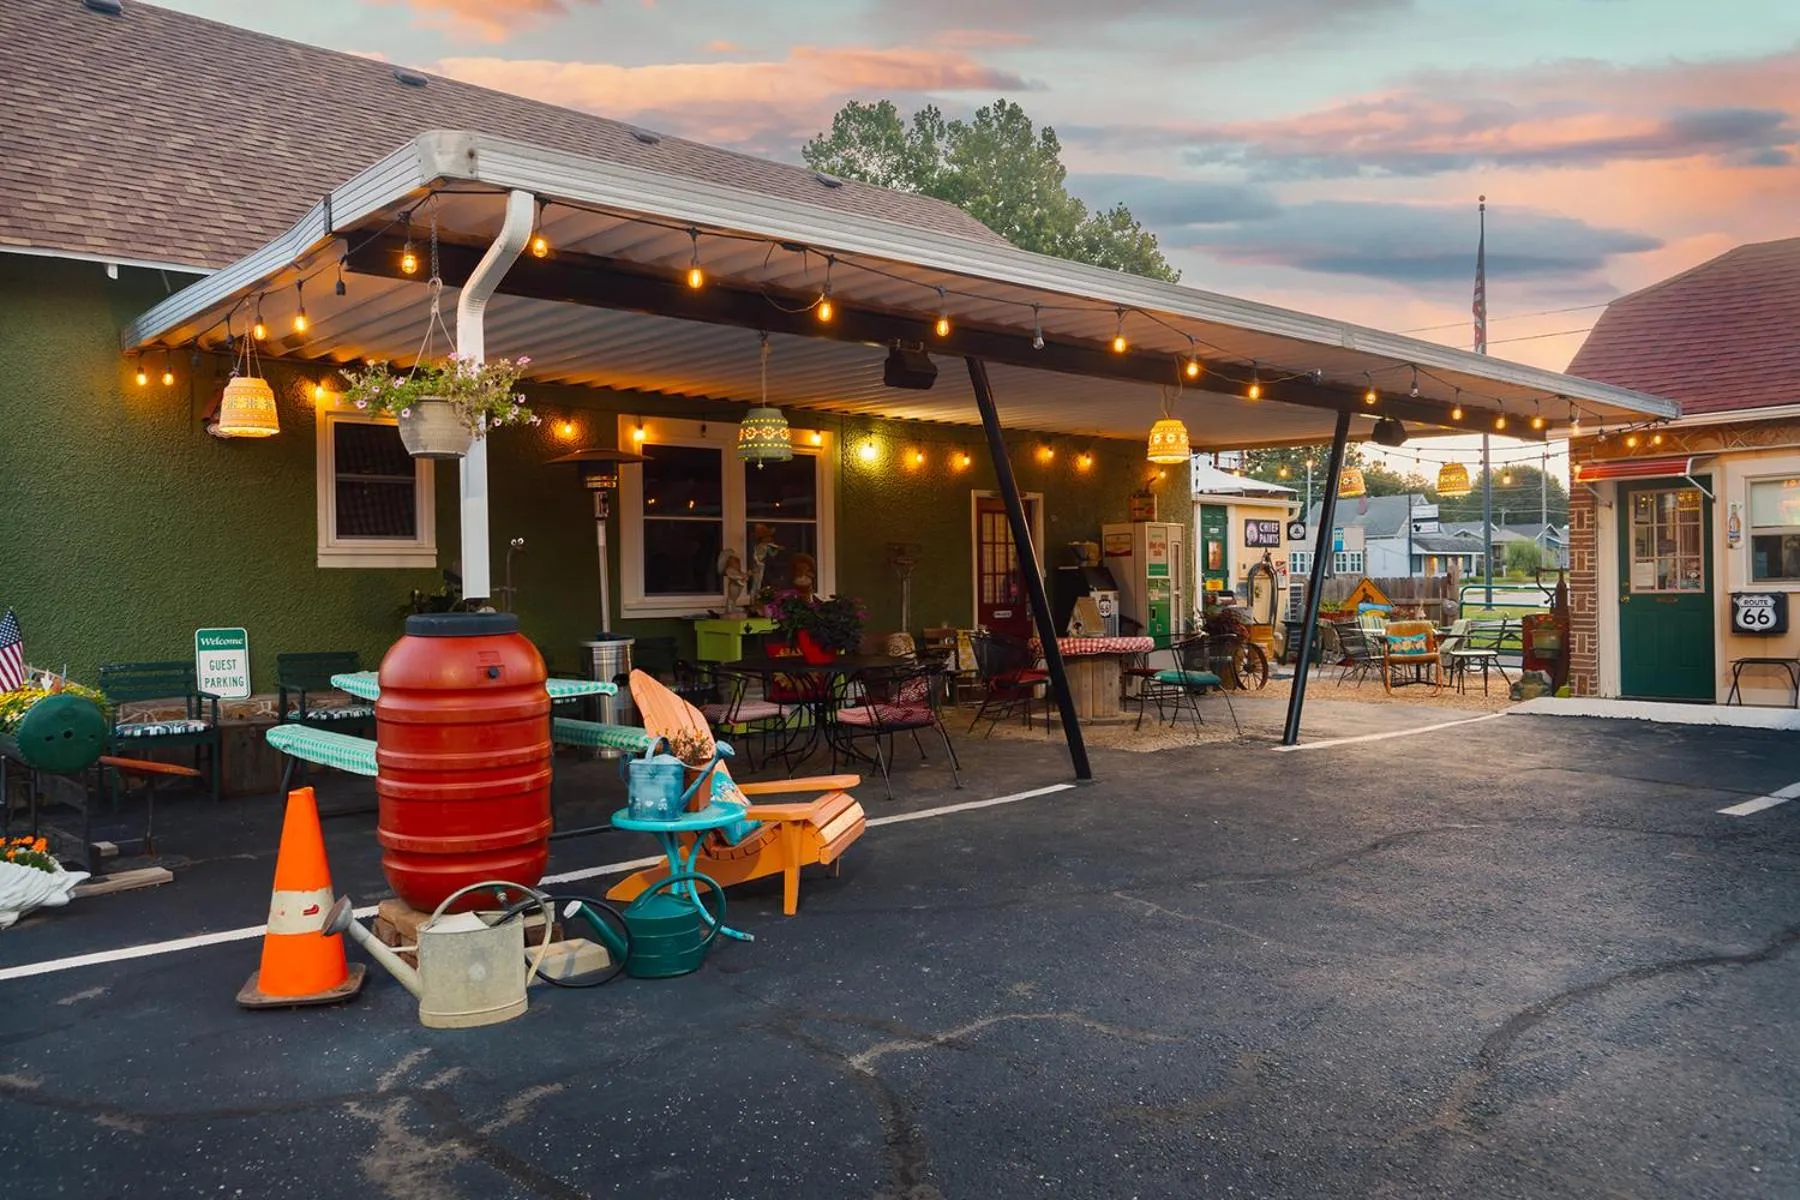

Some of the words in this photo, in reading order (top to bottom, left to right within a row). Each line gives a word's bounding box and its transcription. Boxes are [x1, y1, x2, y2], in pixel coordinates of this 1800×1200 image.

[1259, 522, 1279, 533] CHIEF
[1743, 609, 1769, 624] 66
[200, 635, 243, 646] Welcome
[209, 659, 237, 671] GUEST
[204, 676, 245, 689] PARKING
